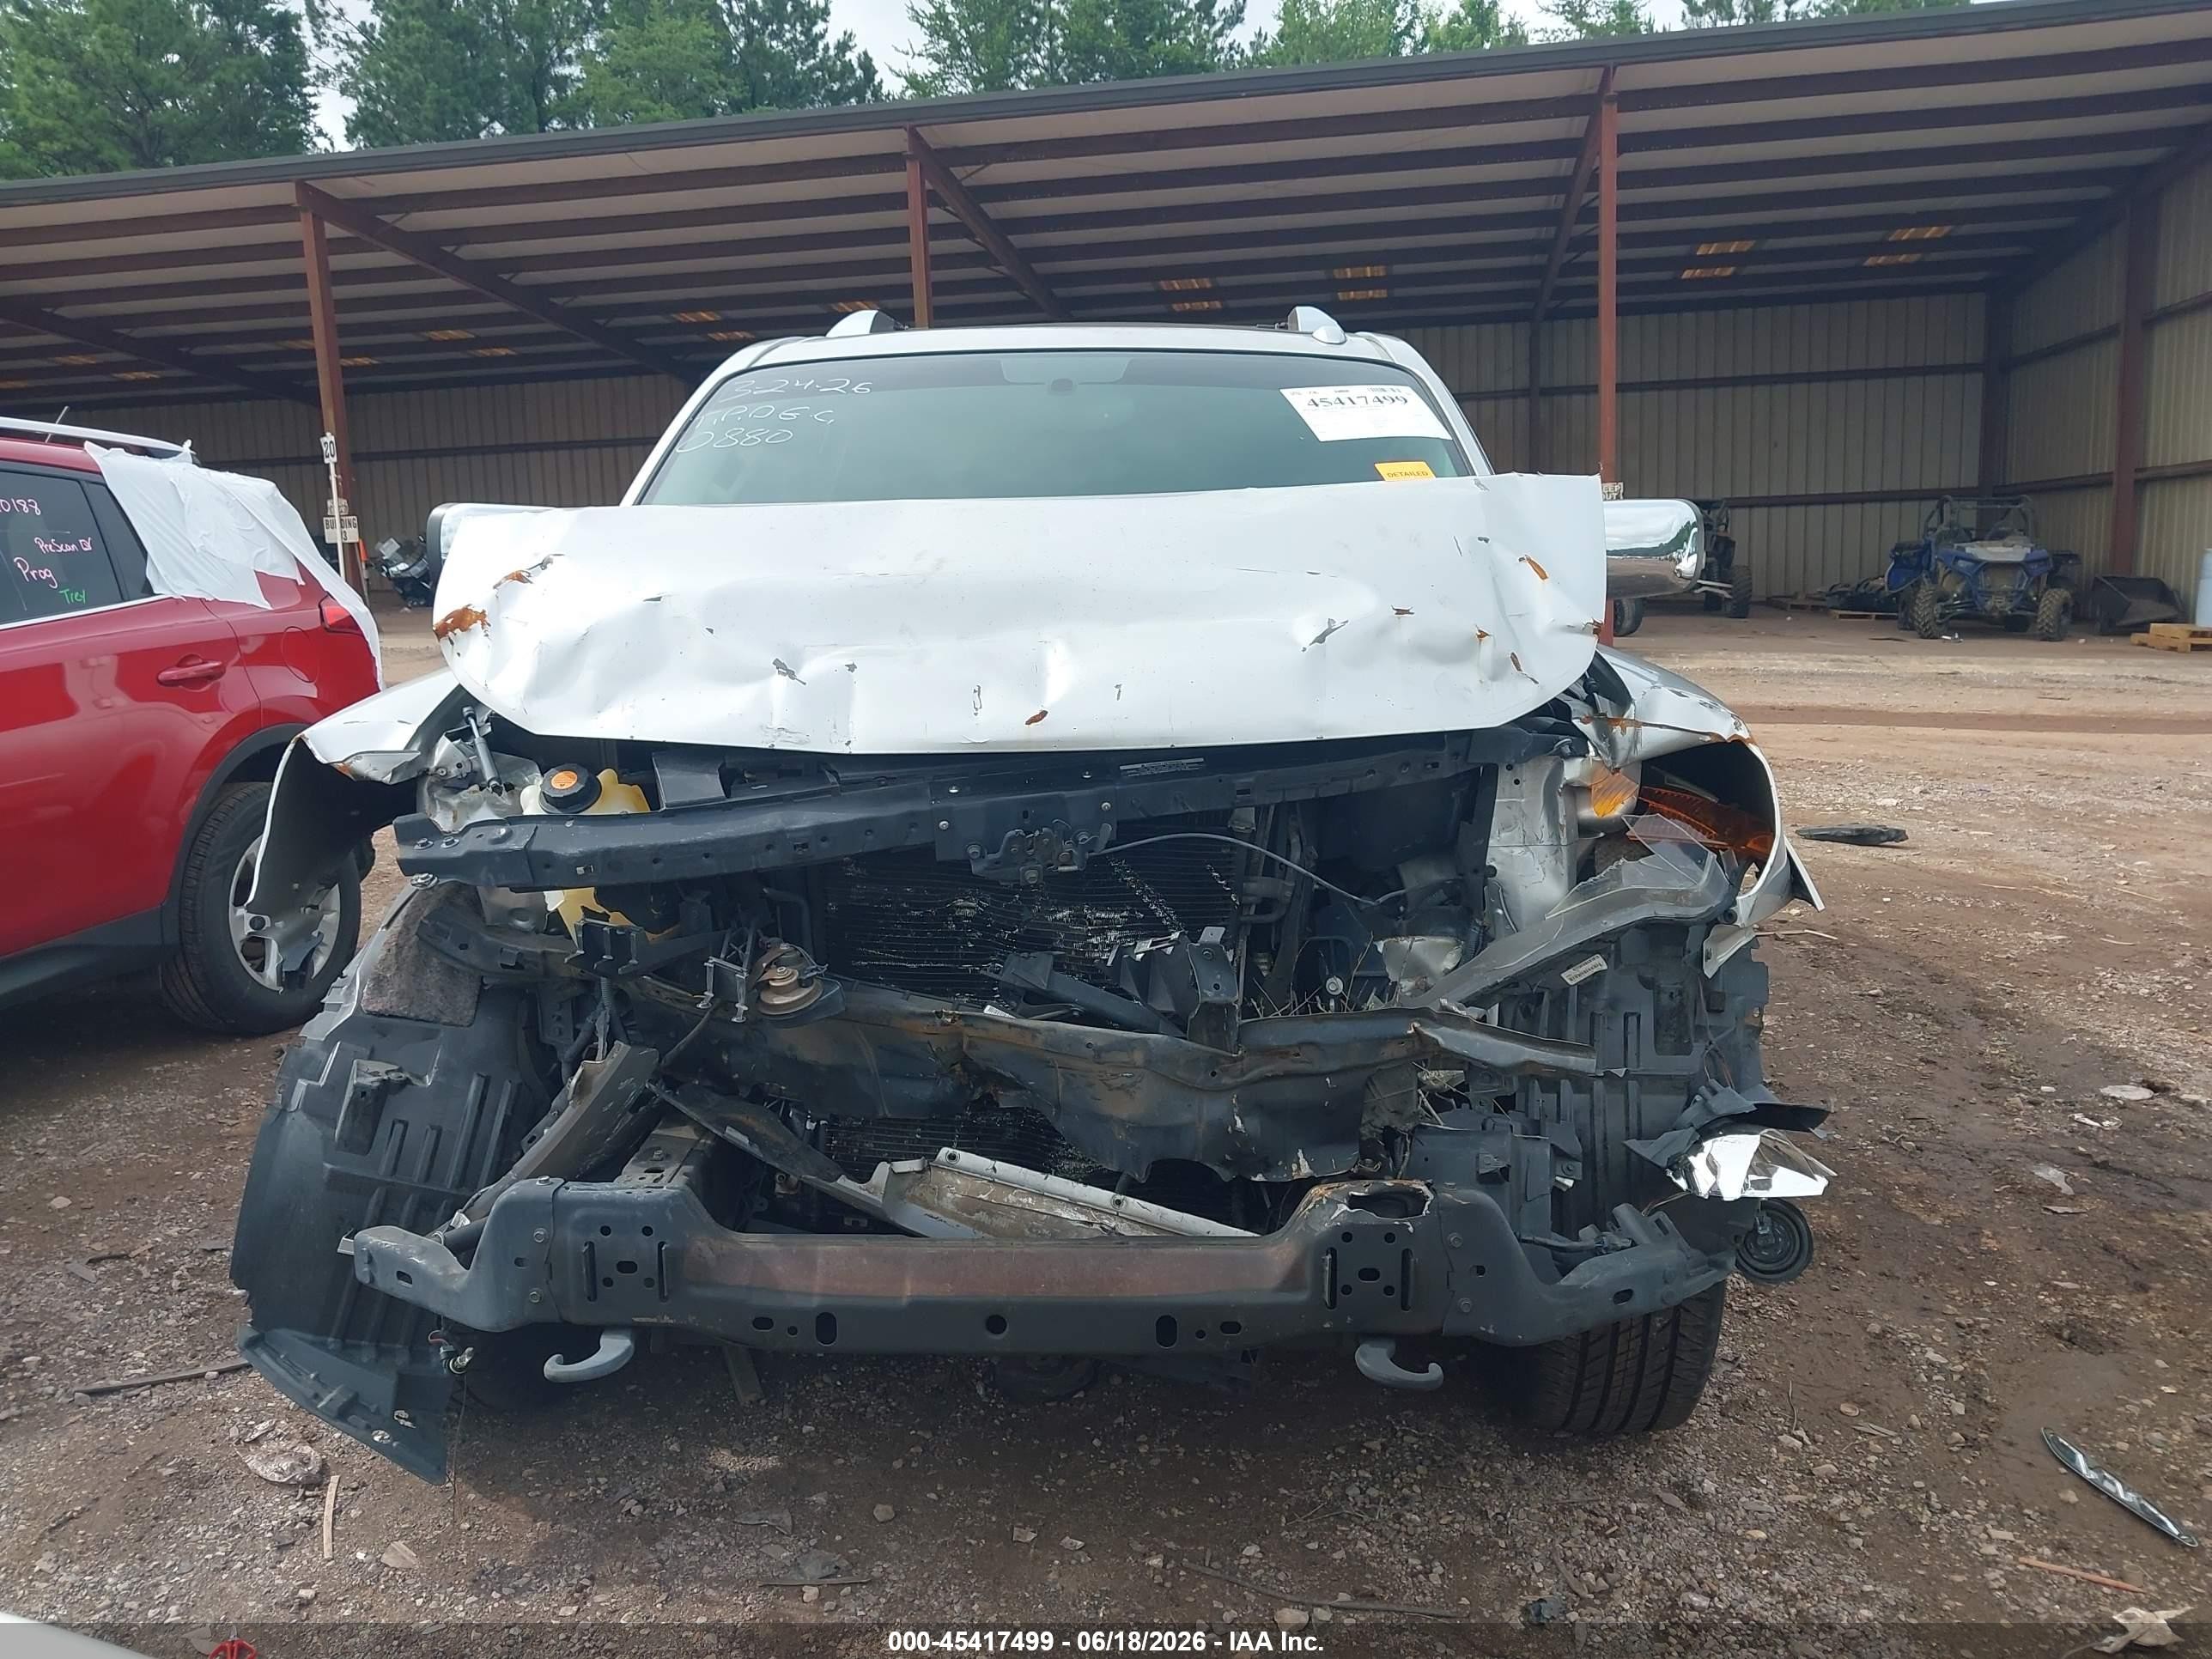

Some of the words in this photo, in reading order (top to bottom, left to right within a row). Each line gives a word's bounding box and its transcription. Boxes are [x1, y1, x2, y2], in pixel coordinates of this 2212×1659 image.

[1307, 395, 1409, 408] 45417499
[324, 441, 335, 458] 20
[0, 497, 41, 515] 0188
[325, 517, 357, 530] BUIDING
[14, 557, 58, 589] Prog
